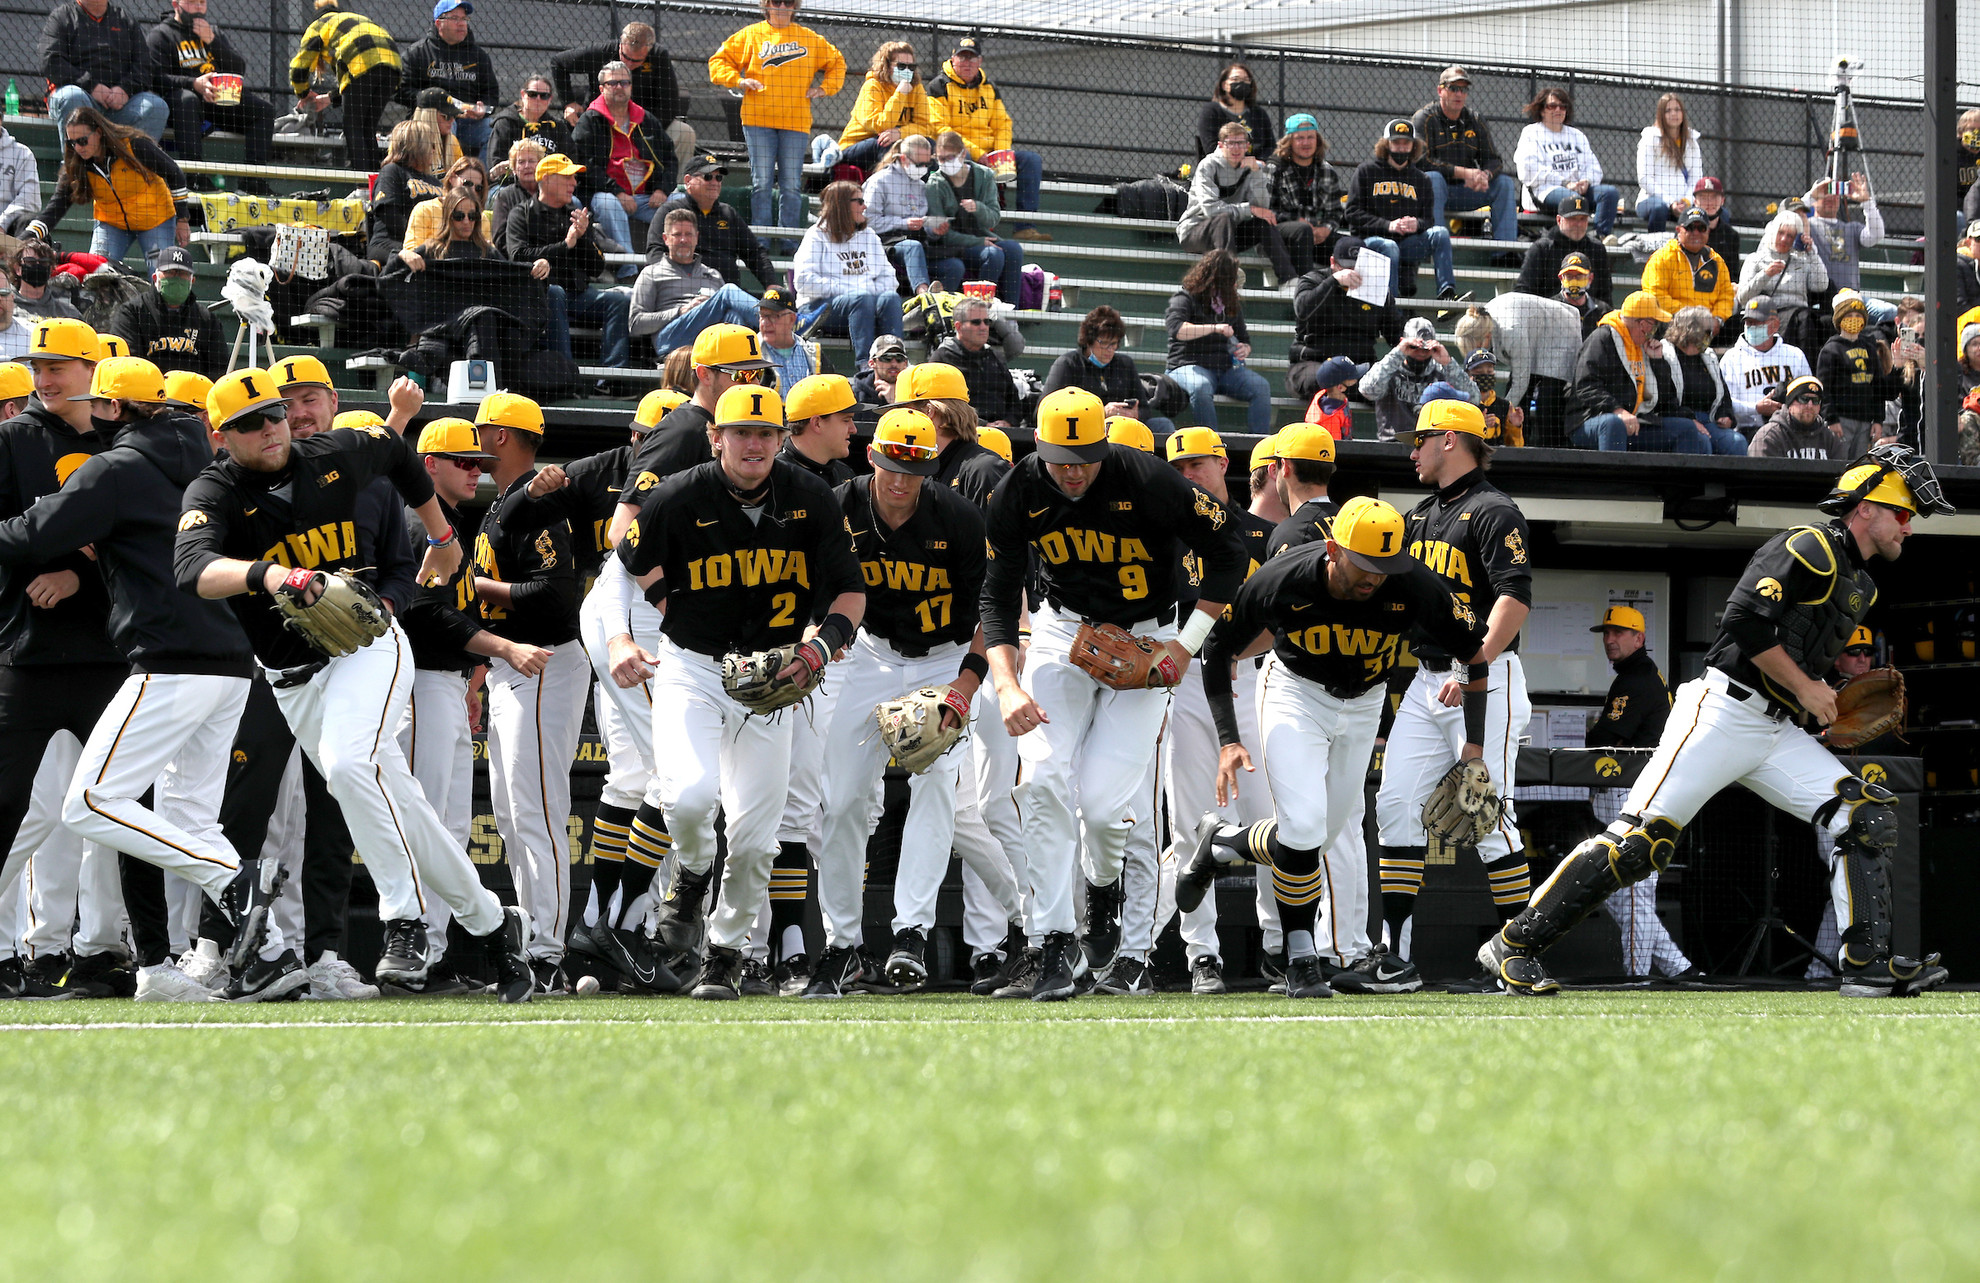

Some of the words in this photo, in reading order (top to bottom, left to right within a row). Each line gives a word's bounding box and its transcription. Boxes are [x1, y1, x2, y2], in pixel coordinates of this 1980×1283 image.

[758, 41, 800, 59] Iowa
[1372, 181, 1418, 201] IOWA
[836, 250, 866, 261] IOWA
[38, 327, 49, 348] I
[147, 336, 194, 356] IOWA
[746, 334, 758, 356] I
[284, 363, 297, 382] I
[1743, 364, 1794, 389] IOWA
[240, 376, 261, 399] I
[750, 394, 763, 416] I
[470, 427, 480, 446] I
[1066, 417, 1079, 440] I
[1175, 435, 1185, 453] I
[1380, 531, 1394, 553] I
[688, 548, 810, 591] IOWA
[860, 557, 952, 592] OWA
[1409, 540, 1474, 588] OWA
[1118, 564, 1149, 601] 9
[768, 591, 797, 628] 2
[914, 593, 953, 634] 17
[1606, 608, 1613, 621] I
[1287, 623, 1401, 657] IOWA
[1858, 628, 1866, 641] I
